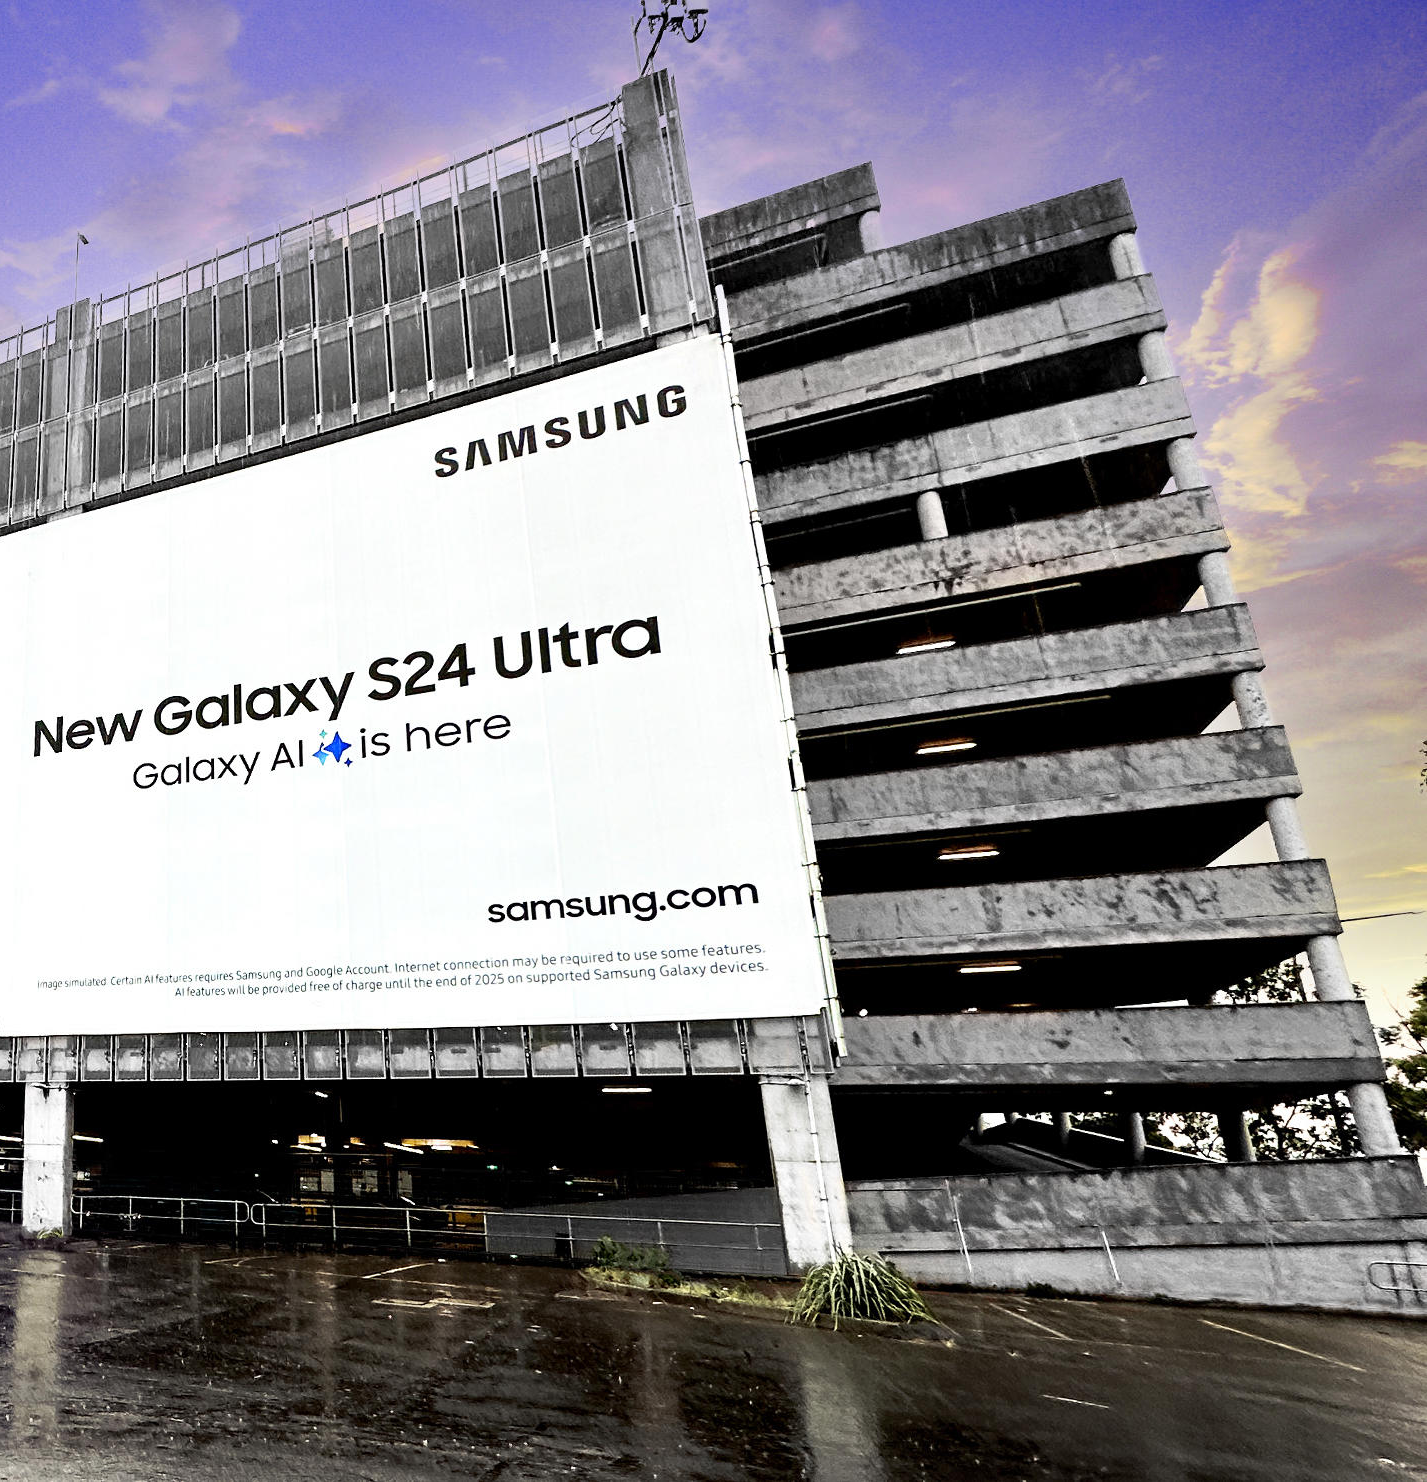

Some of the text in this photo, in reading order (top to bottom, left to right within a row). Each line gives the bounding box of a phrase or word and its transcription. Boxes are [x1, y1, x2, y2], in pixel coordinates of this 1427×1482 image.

[434, 384, 688, 479] SAMSUNG
[32, 614, 663, 759] New Galaxy S24 Ultra
[132, 713, 512, 791] Galaxy AI is here
[487, 882, 760, 924] samsung.com
[111, 974, 142, 986] Certain
[144, 974, 154, 984] AI
[156, 973, 193, 984] features
[194, 972, 234, 984] requires
[235, 969, 282, 981] Samsung
[284, 967, 304, 978] and
[305, 965, 344, 977] Google
[394, 961, 441, 973] Internet
[443, 958, 509, 972] connection
[512, 957, 539, 969] may
[541, 954, 557, 966] be
[560, 951, 614, 966] required
[616, 951, 631, 962] to
[633, 950, 658, 961] use
[659, 948, 699, 960] some
[701, 944, 767, 957] features.
[175, 961, 769, 997] AI features will be provided free of charge until the end of 2025 on supported Samsung Galaxy devices.
